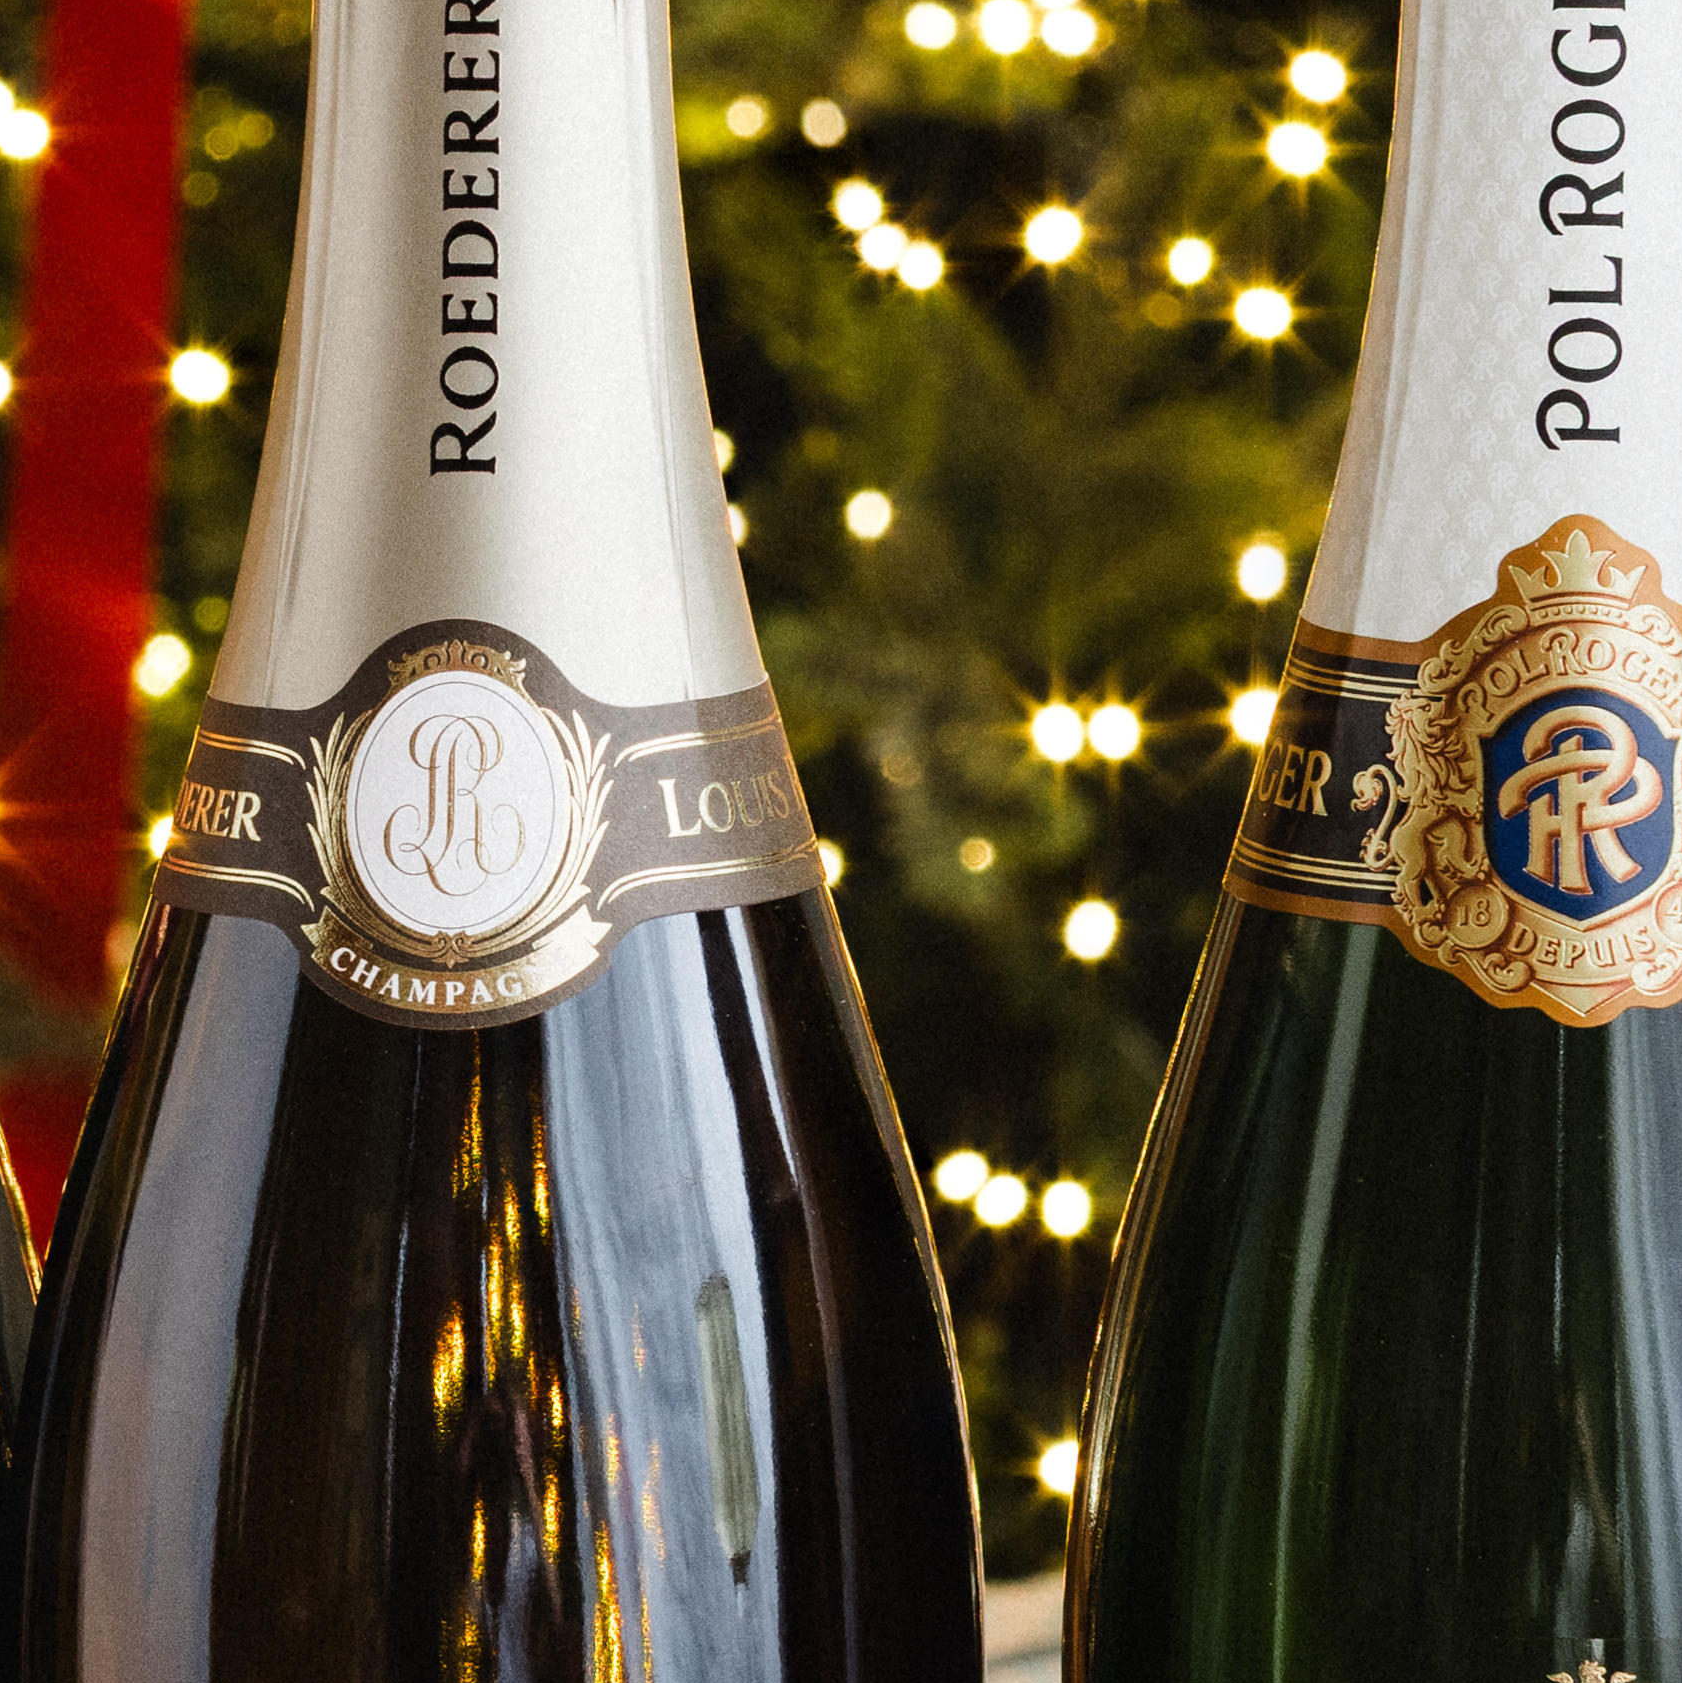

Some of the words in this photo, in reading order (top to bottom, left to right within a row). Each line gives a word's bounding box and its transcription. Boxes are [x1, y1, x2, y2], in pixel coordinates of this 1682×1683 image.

[1535, 255, 1623, 450] POL
[1457, 649, 1548, 722] POL
[658, 771, 789, 838] LOUIS
[1457, 898, 1491, 927] 18
[330, 947, 524, 1006] CHAMPAG
[1507, 922, 1656, 968] DEPUIS
